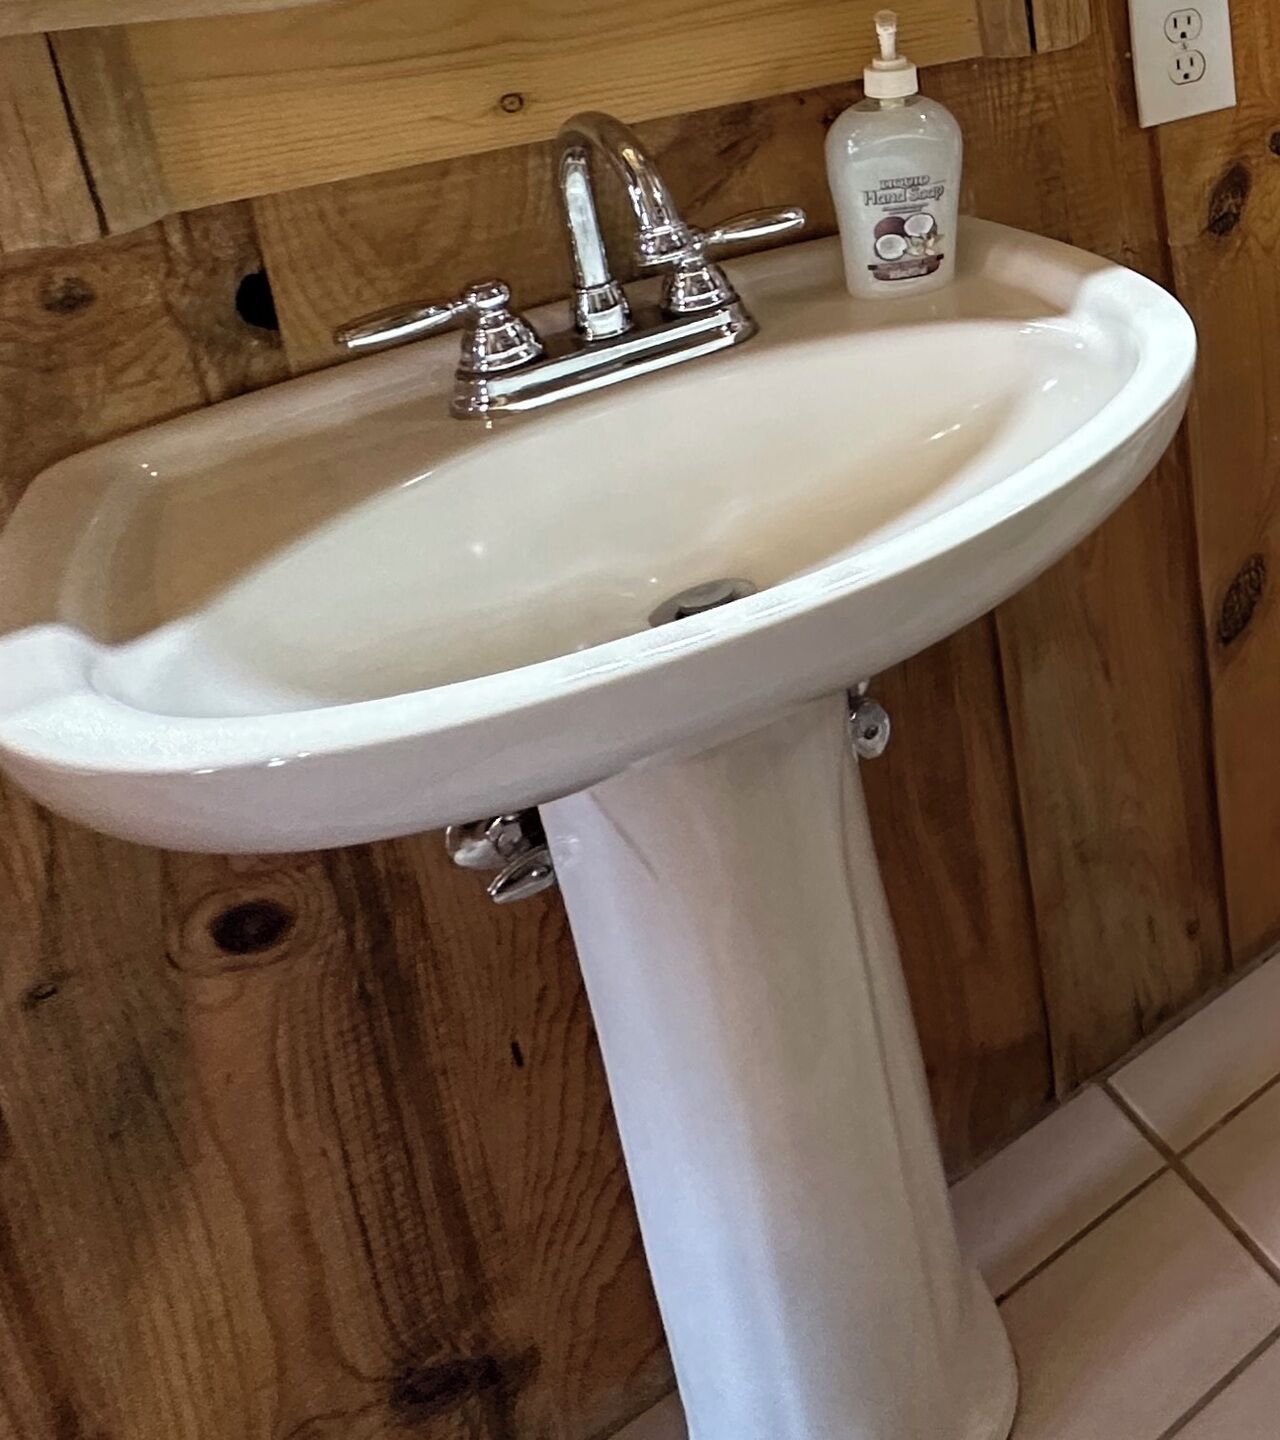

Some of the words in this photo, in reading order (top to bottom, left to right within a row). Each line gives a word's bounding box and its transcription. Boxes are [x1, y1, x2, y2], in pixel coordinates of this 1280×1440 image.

[879, 175, 930, 190] LIQUID
[863, 187, 907, 206] Hand
[906, 185, 945, 202] Soap
